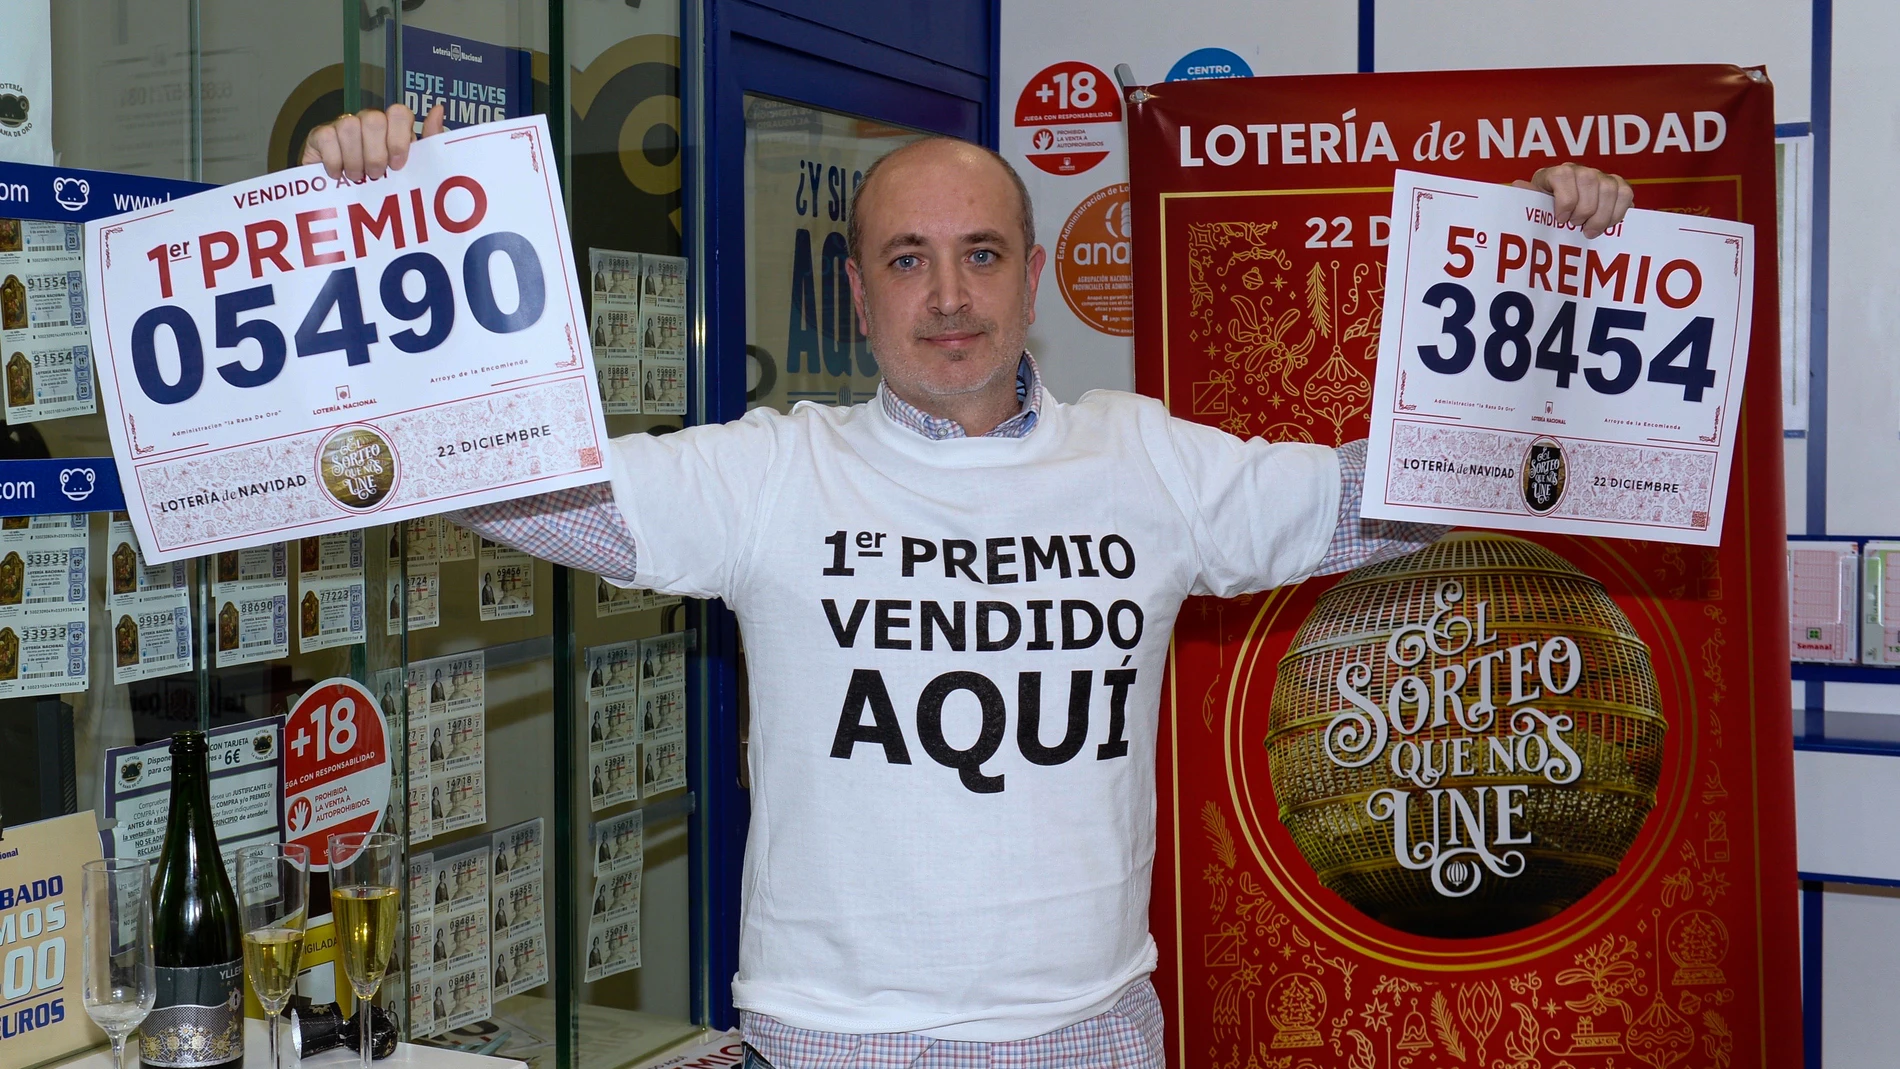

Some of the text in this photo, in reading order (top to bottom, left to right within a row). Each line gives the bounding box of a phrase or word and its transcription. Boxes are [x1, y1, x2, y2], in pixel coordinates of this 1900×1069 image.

[432, 46, 450, 57] Lotería
[1187, 64, 1231, 75] CENTRO
[0, 83, 23, 94] OTERÍA
[405, 70, 506, 106] ESTE JUEVES
[1036, 71, 1097, 110] +18
[1058, 112, 1113, 120] RESPONSABILIDAD
[0, 129, 12, 138] ANA
[1180, 107, 1728, 168] LOTERÍA de NAVIDAD
[233, 175, 327, 210] VENDIDO
[795, 159, 822, 218] ¿Y
[147, 175, 488, 298] 1er PREMIO
[1304, 216, 1352, 248] 22
[1073, 242, 1131, 266] ana
[1496, 232, 1703, 309] PREMIO
[28, 277, 67, 289] 91554
[131, 231, 547, 405] 05490
[1417, 282, 1716, 403] 38454
[33, 351, 72, 365] 91554
[430, 374, 456, 384] Arroyo
[470, 368, 479, 376] la
[481, 358, 529, 373] Encomienda
[313, 399, 377, 416] LOTERÍA NACIONAL
[1434, 398, 1475, 408] Administracion
[172, 421, 222, 437] Administracion
[236, 417, 254, 425] Rana
[1604, 417, 1625, 426] Arroyo
[1643, 421, 1682, 430] Encomienda
[437, 424, 551, 458] 22 DICIEMBRE
[1403, 457, 1515, 480] LOTERÍA de NAVIDAD
[1593, 476, 1680, 494] 22 DICIEMBRE
[161, 475, 307, 513] LOTERÍA de NAVIDAD
[27, 553, 68, 566] 33933
[822, 530, 1136, 585] 1er PREMIO
[496, 567, 521, 577] 69456
[320, 590, 349, 601] 77223
[241, 600, 273, 613] 88690
[139, 612, 174, 627] 99994
[820, 598, 1144, 652] VENDIDO
[1387, 580, 1499, 667] EL
[22, 627, 66, 641] 33933
[1797, 642, 1832, 650] Semanal
[449, 659, 473, 672] 14718
[605, 702, 625, 714] 43934
[1324, 636, 1582, 768] SORTEO
[290, 696, 358, 762] +18
[447, 717, 472, 730] 14718
[830, 655, 1138, 794] AQUÍ
[223, 737, 249, 749] TARJETA
[1390, 707, 1582, 788] QUE NOS
[224, 748, 241, 765] 6€
[147, 767, 162, 777] para
[286, 751, 375, 790] EGA CON RESPONSABILIDAD
[446, 776, 472, 789] 14718
[211, 792, 225, 801] desea
[232, 783, 267, 796] JUSTIFICANTE
[216, 798, 239, 808] COMPRA
[249, 791, 271, 801] PREMIOS
[314, 785, 348, 803] PROHIBIDA
[221, 807, 233, 817] favor
[315, 804, 324, 813] LA
[324, 797, 345, 810] VENTA
[316, 797, 371, 823] AUTOPROHIBIDOS
[133, 811, 155, 821] COMPRA
[213, 808, 269, 828] PRINCIPIO de atenderle
[127, 819, 153, 831] ANTES de
[122, 833, 129, 841] la
[135, 837, 152, 848] NO SE
[1366, 784, 1532, 897] UNE
[0, 847, 19, 860] ional
[451, 857, 477, 872] 08484
[0, 874, 64, 912] BADO
[509, 883, 533, 899] 84359
[0, 899, 67, 946] MOS
[449, 914, 475, 929] 08484
[605, 924, 628, 939] 35078
[303, 937, 339, 955] IGILADA
[509, 938, 534, 954] 84359
[2, 936, 67, 1000] 00
[448, 972, 476, 987] 08484
